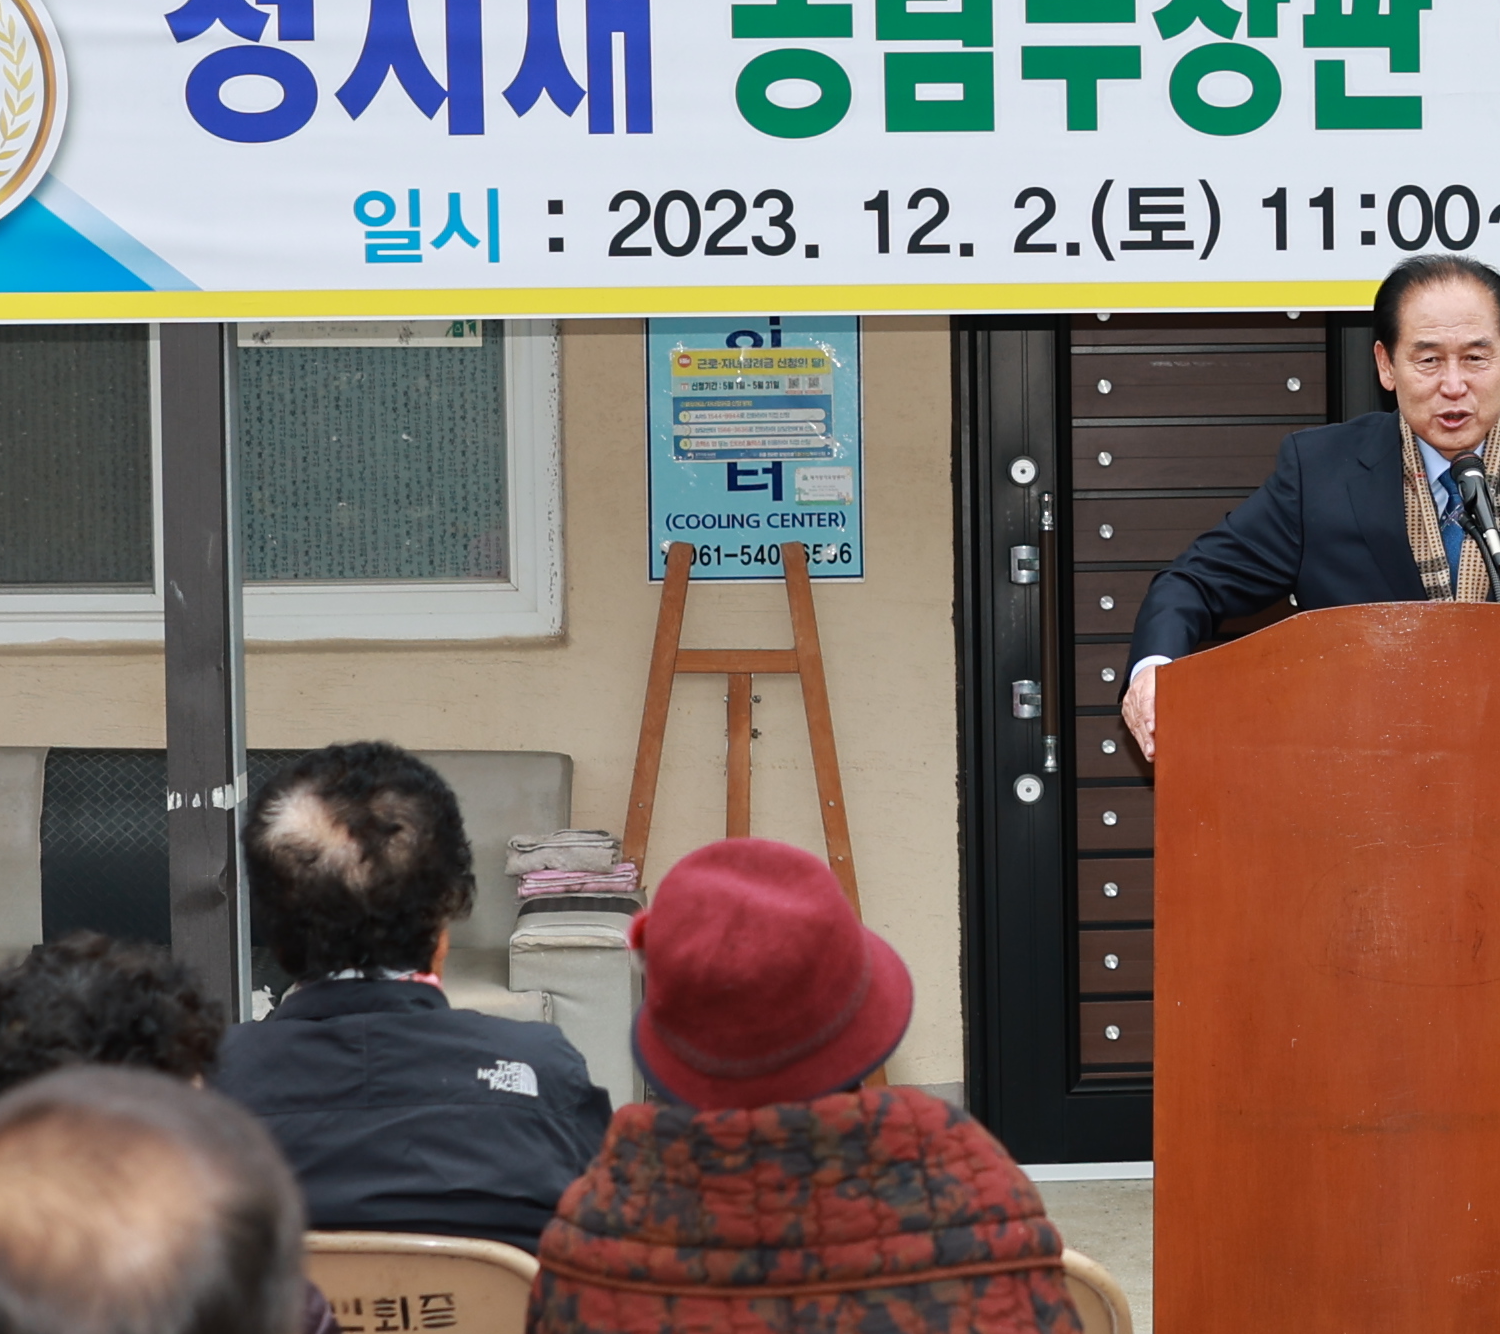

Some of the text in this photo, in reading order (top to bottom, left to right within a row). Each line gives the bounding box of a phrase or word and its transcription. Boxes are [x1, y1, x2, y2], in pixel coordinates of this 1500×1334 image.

[354, 188, 500, 263] 일시
[608, 187, 820, 259] 2023.
[864, 186, 974, 259] 12.
[1014, 179, 1221, 261] 2.(토)
[665, 511, 847, 532] (COOLING CENTER)
